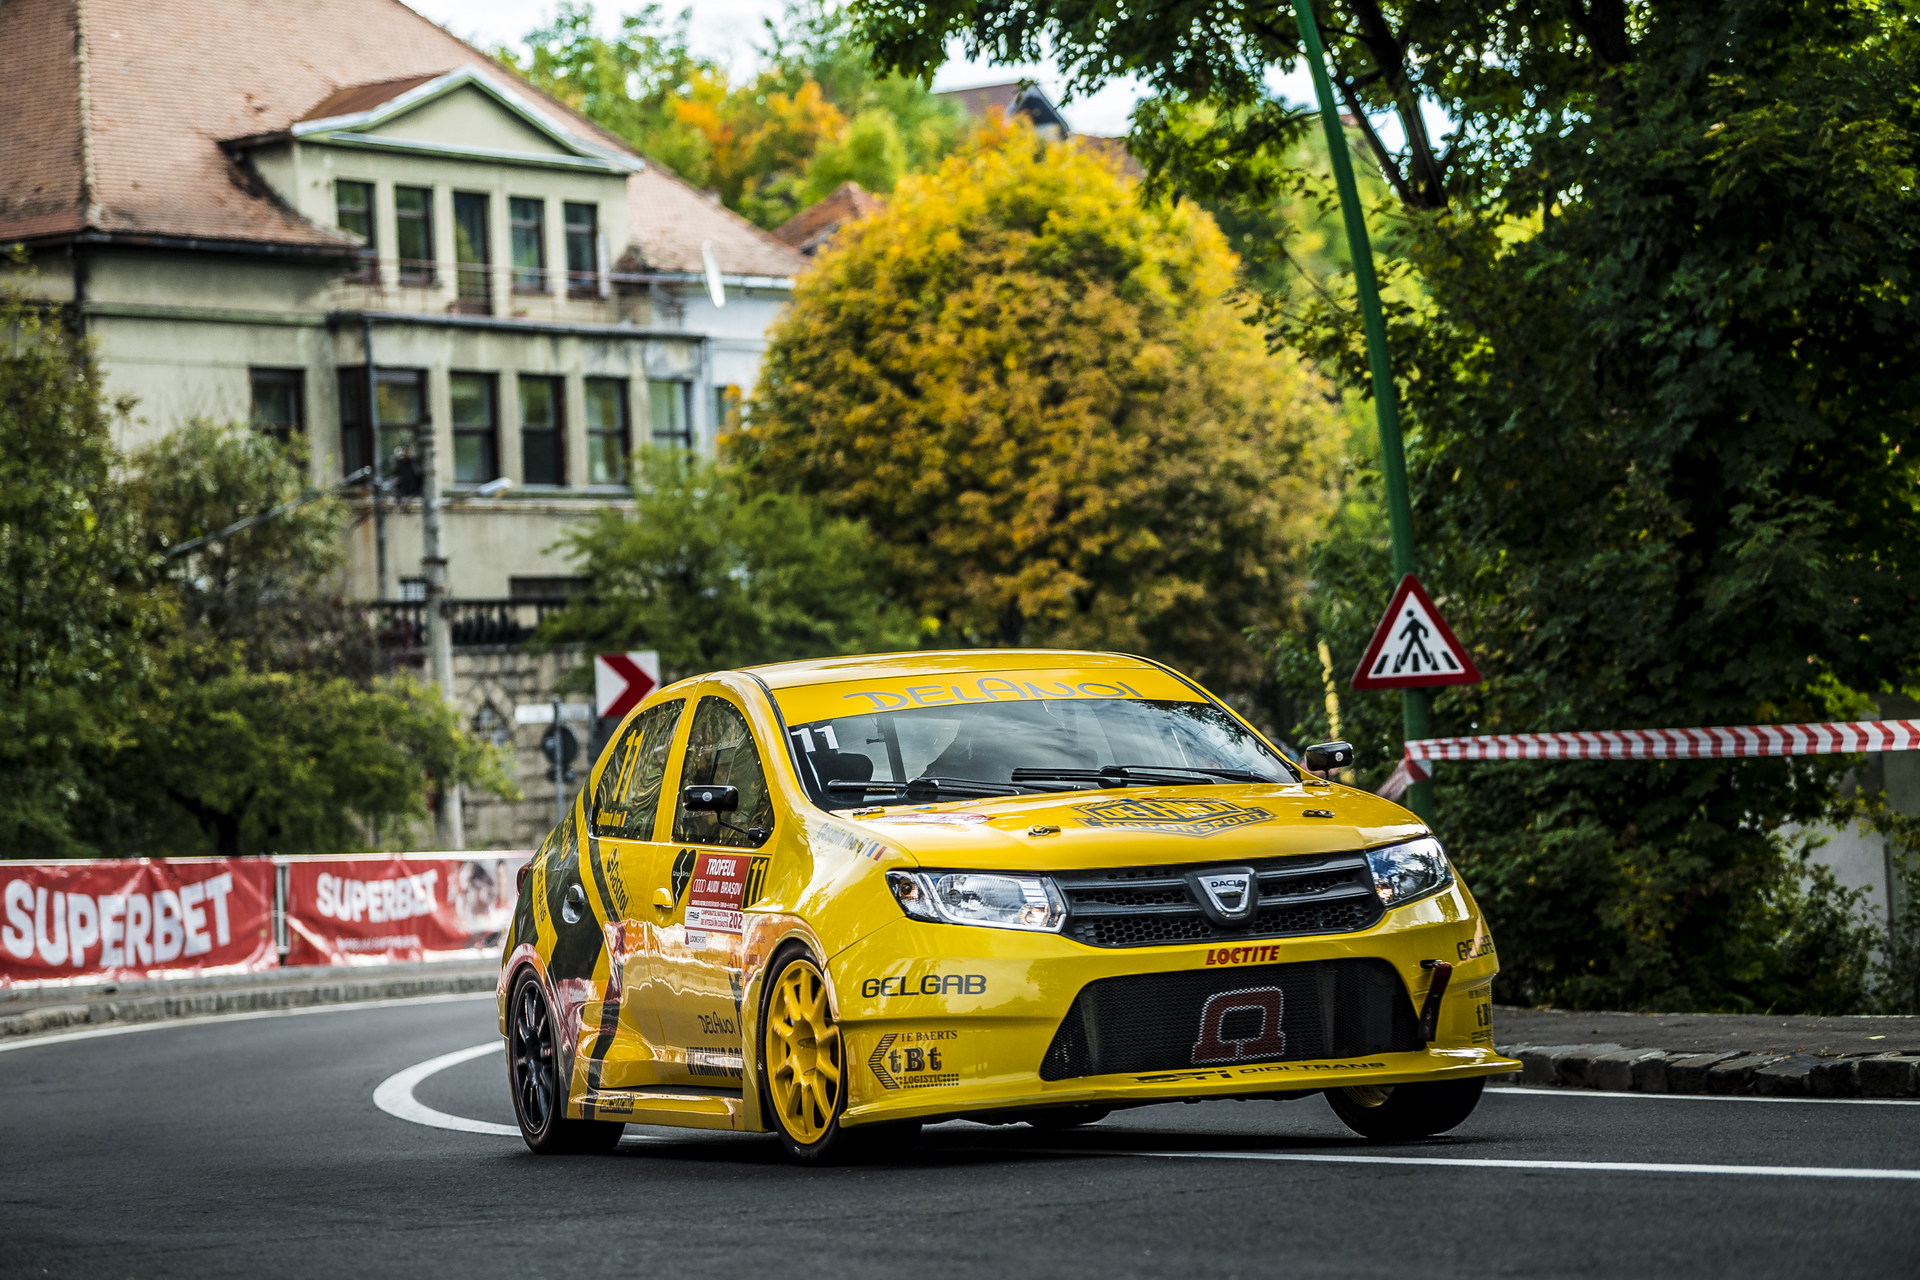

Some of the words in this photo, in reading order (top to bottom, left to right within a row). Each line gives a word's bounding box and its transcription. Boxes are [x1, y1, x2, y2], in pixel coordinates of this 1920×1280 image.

[843, 677, 1144, 711] DELANOI
[790, 725, 839, 753] 11
[613, 729, 645, 802] 11
[1101, 813, 1263, 833] MOTORSPORT
[706, 858, 737, 876] TROFEUL
[609, 860, 630, 918] Castrol
[706, 880, 720, 893] AUDI
[748, 858, 768, 907] 11
[1211, 879, 1248, 891] DACIA
[316, 868, 439, 923] SUPERBET
[2, 871, 233, 968] SUPERBET
[1206, 945, 1280, 966] LOCTITE
[861, 974, 987, 999] GELGAB
[915, 1030, 958, 1042] BAERTS
[888, 1046, 942, 1074] tBt
[1238, 1066, 1291, 1074] DIDI
[1296, 1062, 1387, 1071] TRANS
[903, 1073, 944, 1085] LOGISTIC
